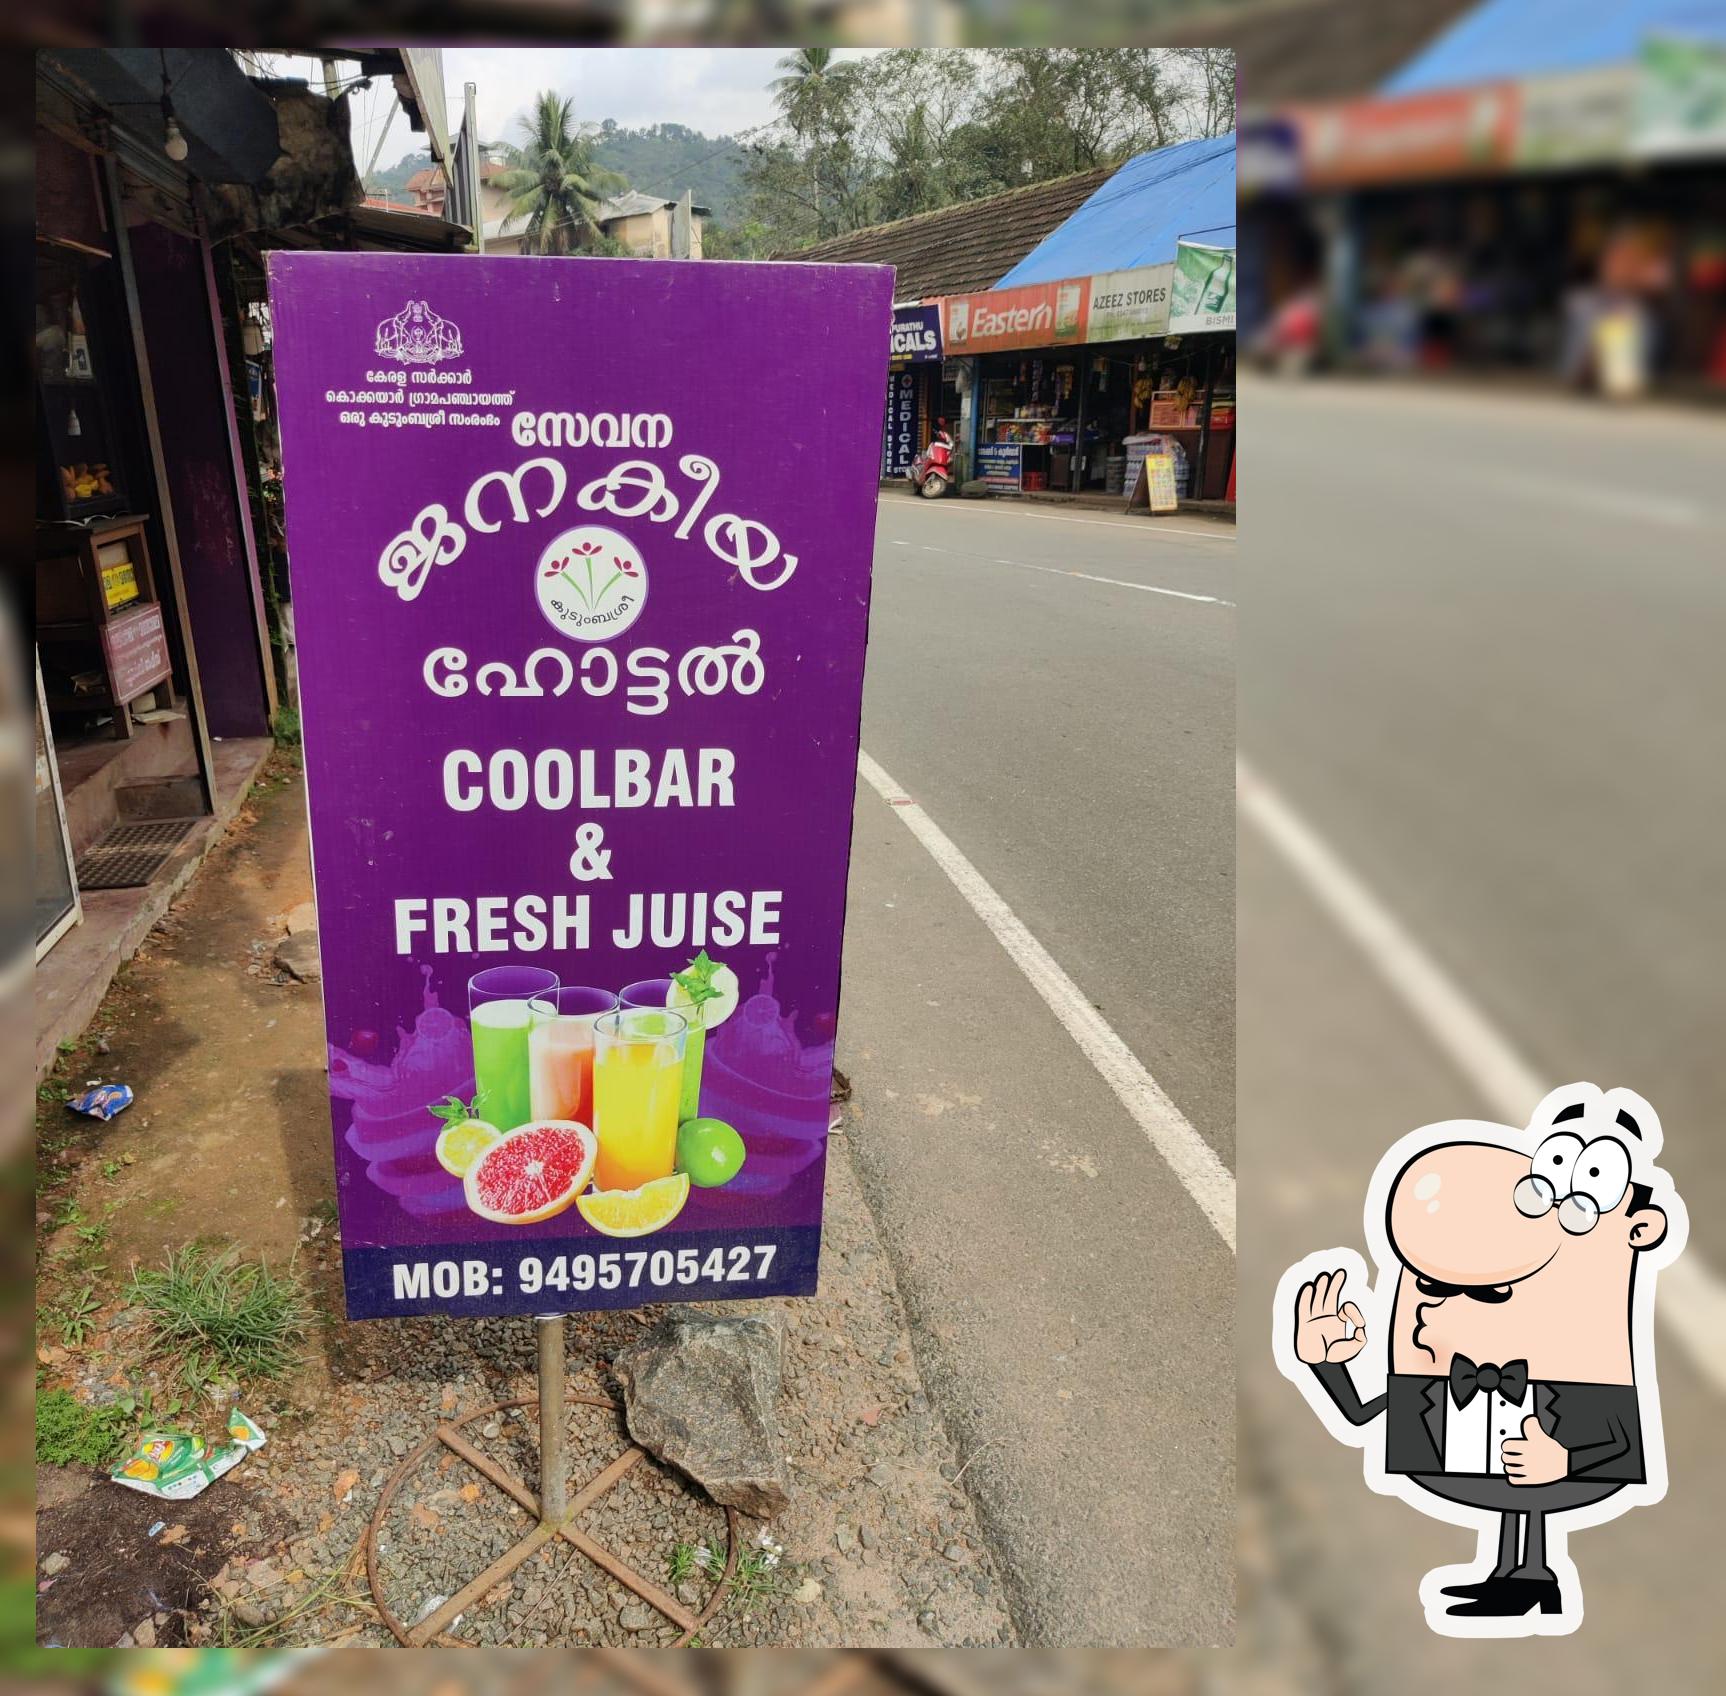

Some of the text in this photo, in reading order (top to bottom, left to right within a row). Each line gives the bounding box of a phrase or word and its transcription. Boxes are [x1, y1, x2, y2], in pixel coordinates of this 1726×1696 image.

[1092, 287, 1167, 310] AZEEZ STORES
[892, 322, 924, 332] PURATHU
[971, 302, 1053, 338] Eastern
[1206, 315, 1235, 326] BISMI
[891, 330, 937, 353] ICALS
[326, 388, 404, 403] കൊക്കയാർ
[366, 368, 472, 387] കേരള സർക്കാർ
[340, 410, 500, 428] ഒരു കുടുംബശ്രീ സംരംഭം
[512, 412, 673, 448] സേവന
[898, 389, 913, 465] MEDICAL
[378, 454, 798, 602] ജനകീയ
[551, 595, 634, 627] കുടുംബശ്രീ
[423, 629, 765, 715] ഹോട്ടൽ
[444, 748, 735, 811] COOLBAR
[570, 823, 613, 881] &
[395, 891, 782, 954] FRESH JUISE
[393, 1245, 777, 1299] MOB: 9495705427
